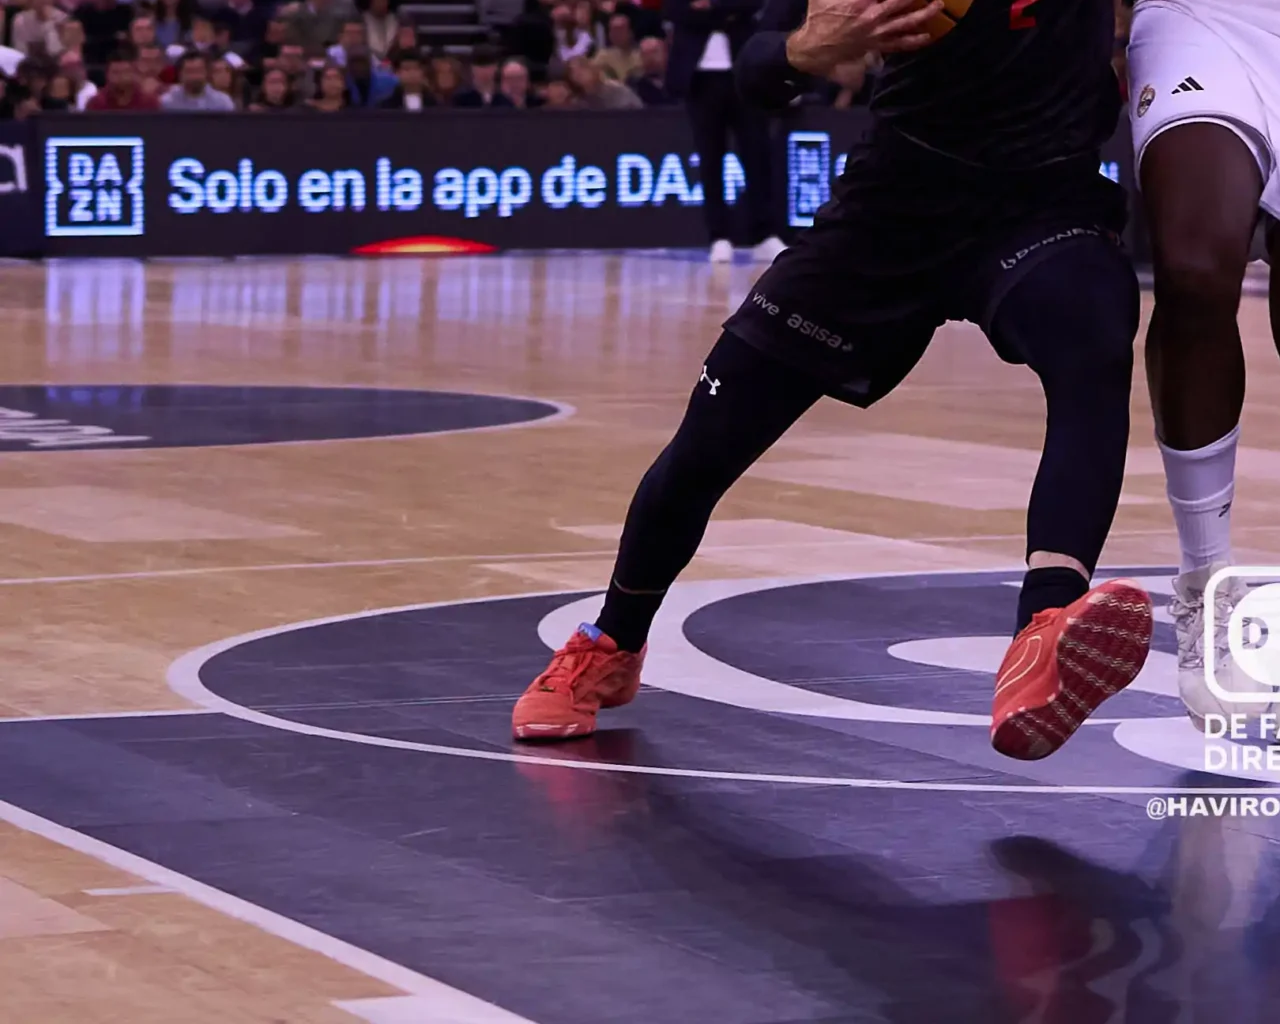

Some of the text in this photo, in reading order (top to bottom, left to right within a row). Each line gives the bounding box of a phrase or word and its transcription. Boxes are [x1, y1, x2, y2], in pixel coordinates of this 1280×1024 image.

[68, 153, 123, 185] DA
[168, 157, 288, 213] Solo
[298, 169, 366, 212] en
[376, 156, 423, 211] la
[433, 167, 532, 218] app
[541, 155, 606, 208] de
[68, 188, 123, 222] ZN
